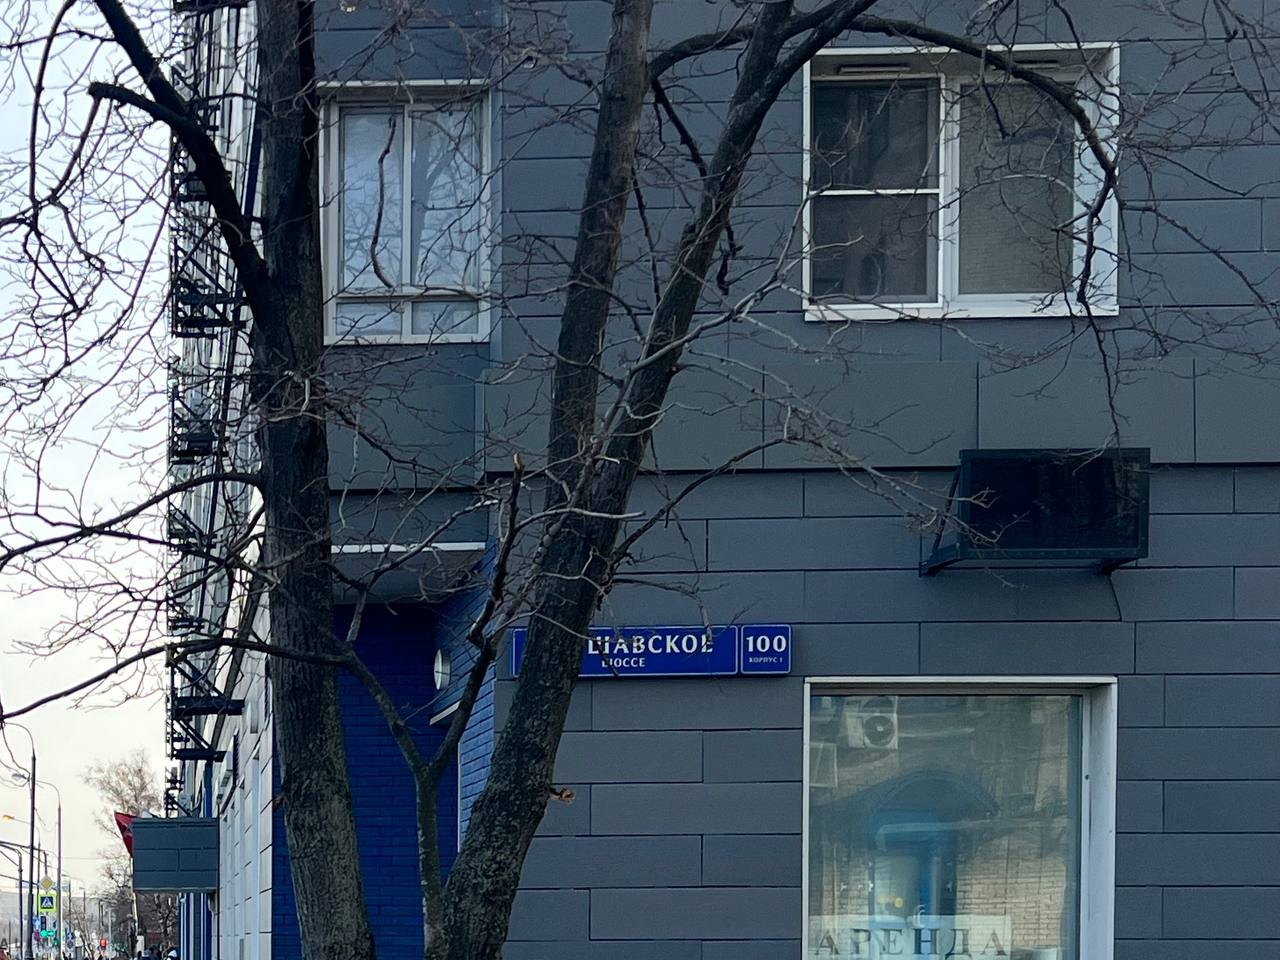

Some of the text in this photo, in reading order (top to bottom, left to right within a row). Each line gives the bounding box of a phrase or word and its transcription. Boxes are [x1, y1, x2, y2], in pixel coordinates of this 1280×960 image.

[588, 634, 713, 654] ШАВСКОЕ
[746, 635, 787, 653] 100
[815, 928, 1008, 960] АРЕНДА
